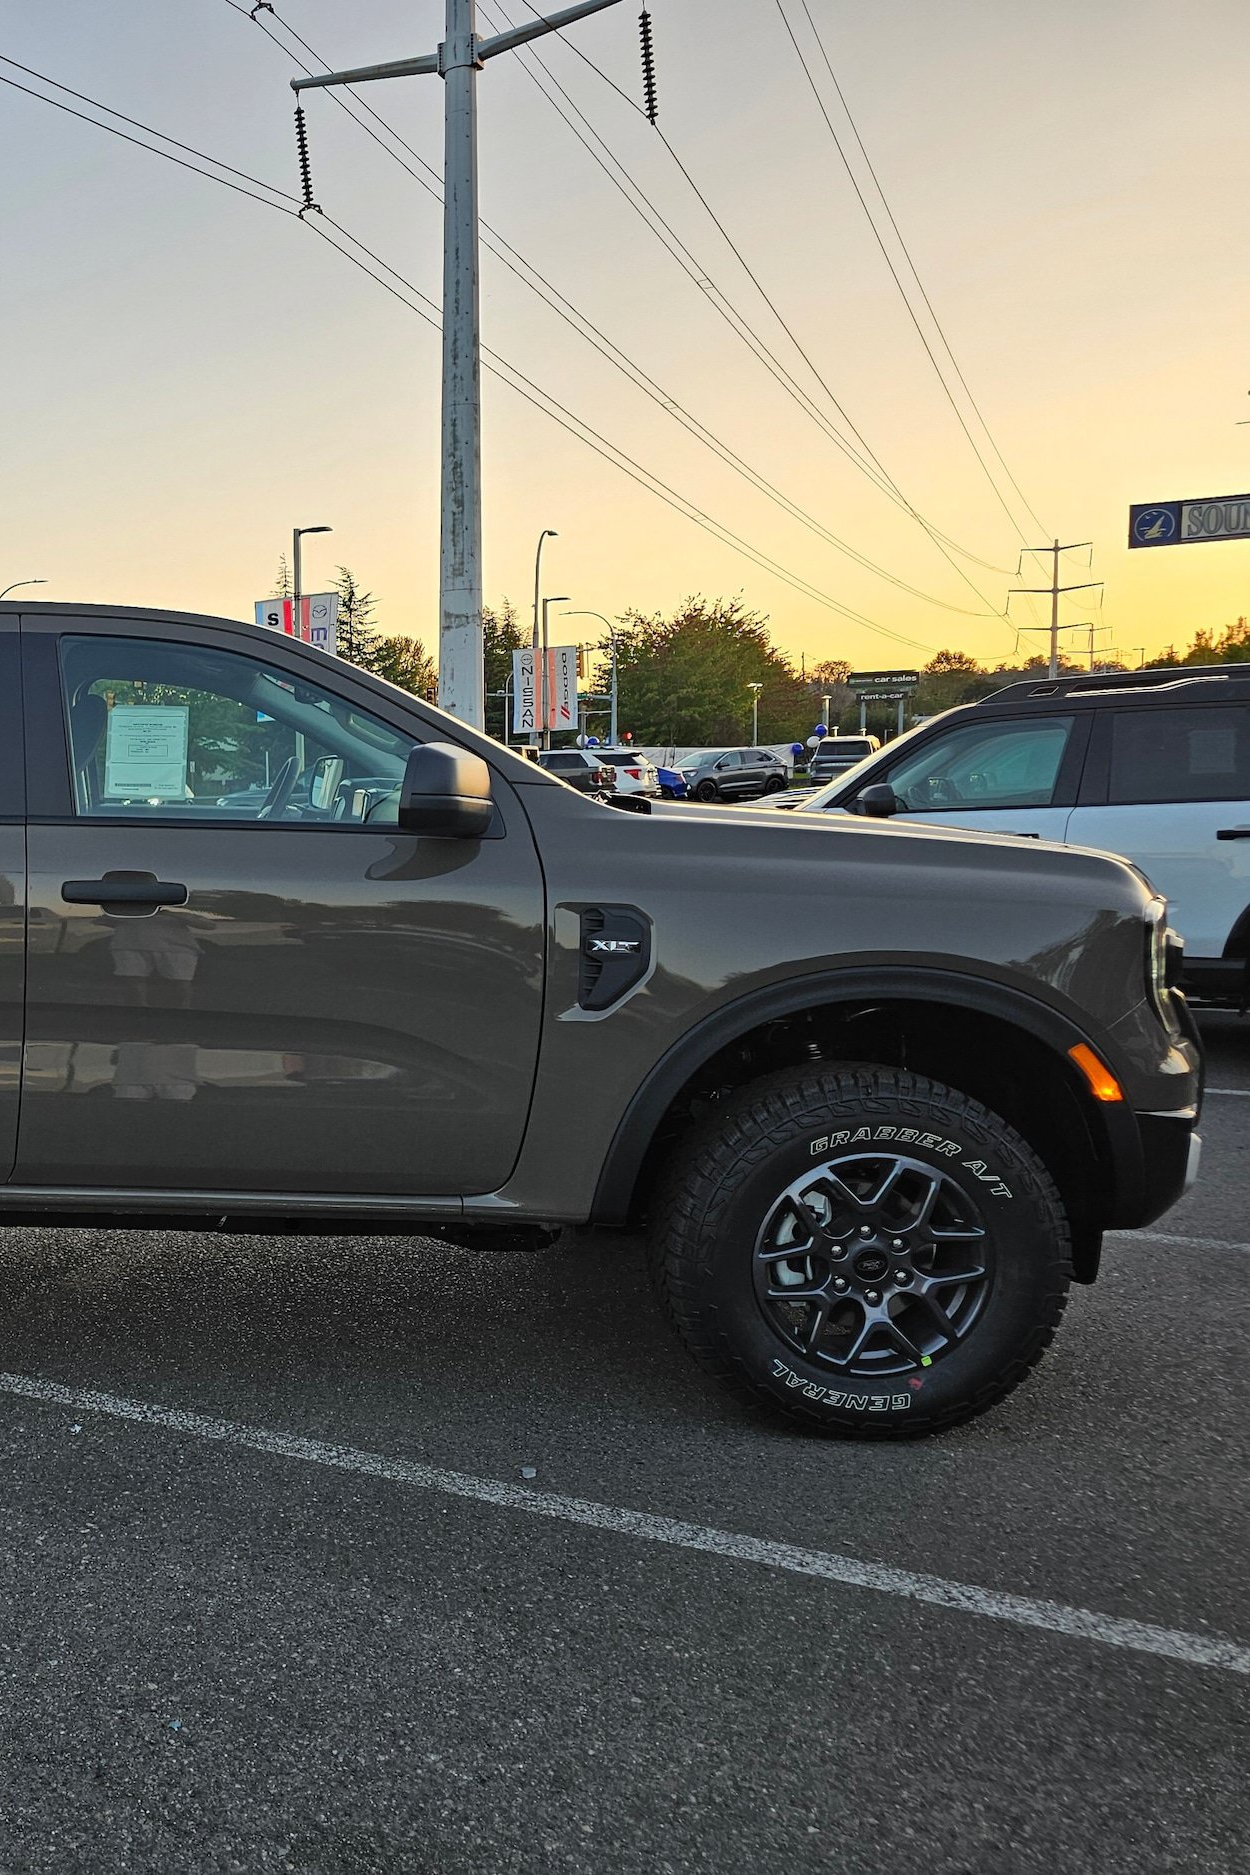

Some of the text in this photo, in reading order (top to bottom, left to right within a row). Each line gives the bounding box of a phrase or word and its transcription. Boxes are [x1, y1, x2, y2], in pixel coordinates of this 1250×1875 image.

[521, 665, 534, 728] NISSAN
[892, 674, 917, 683] sales
[589, 940, 640, 952] XLT
[810, 1126, 1013, 1199] GRABBER A/T
[772, 1358, 911, 1412] GENERAL
